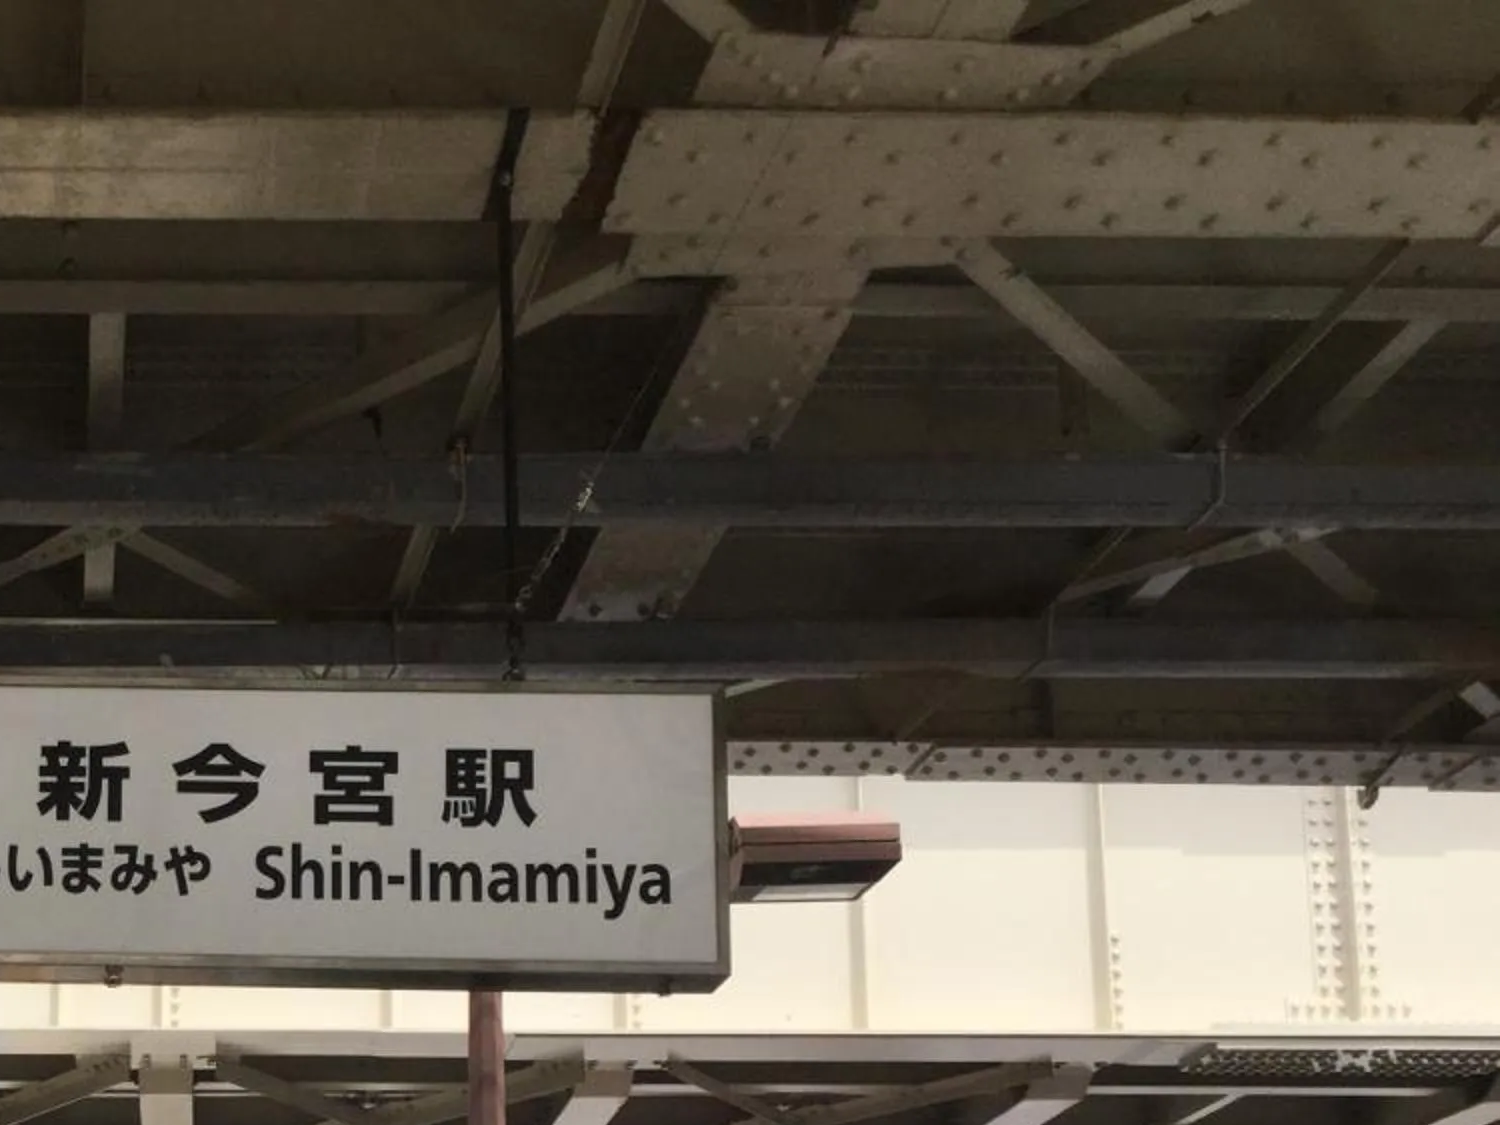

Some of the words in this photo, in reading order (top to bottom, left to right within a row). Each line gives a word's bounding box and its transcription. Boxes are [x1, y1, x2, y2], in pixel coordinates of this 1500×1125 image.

[37, 741, 537, 828] 新今宮駅
[255, 843, 672, 920] Shin-Imamiya
